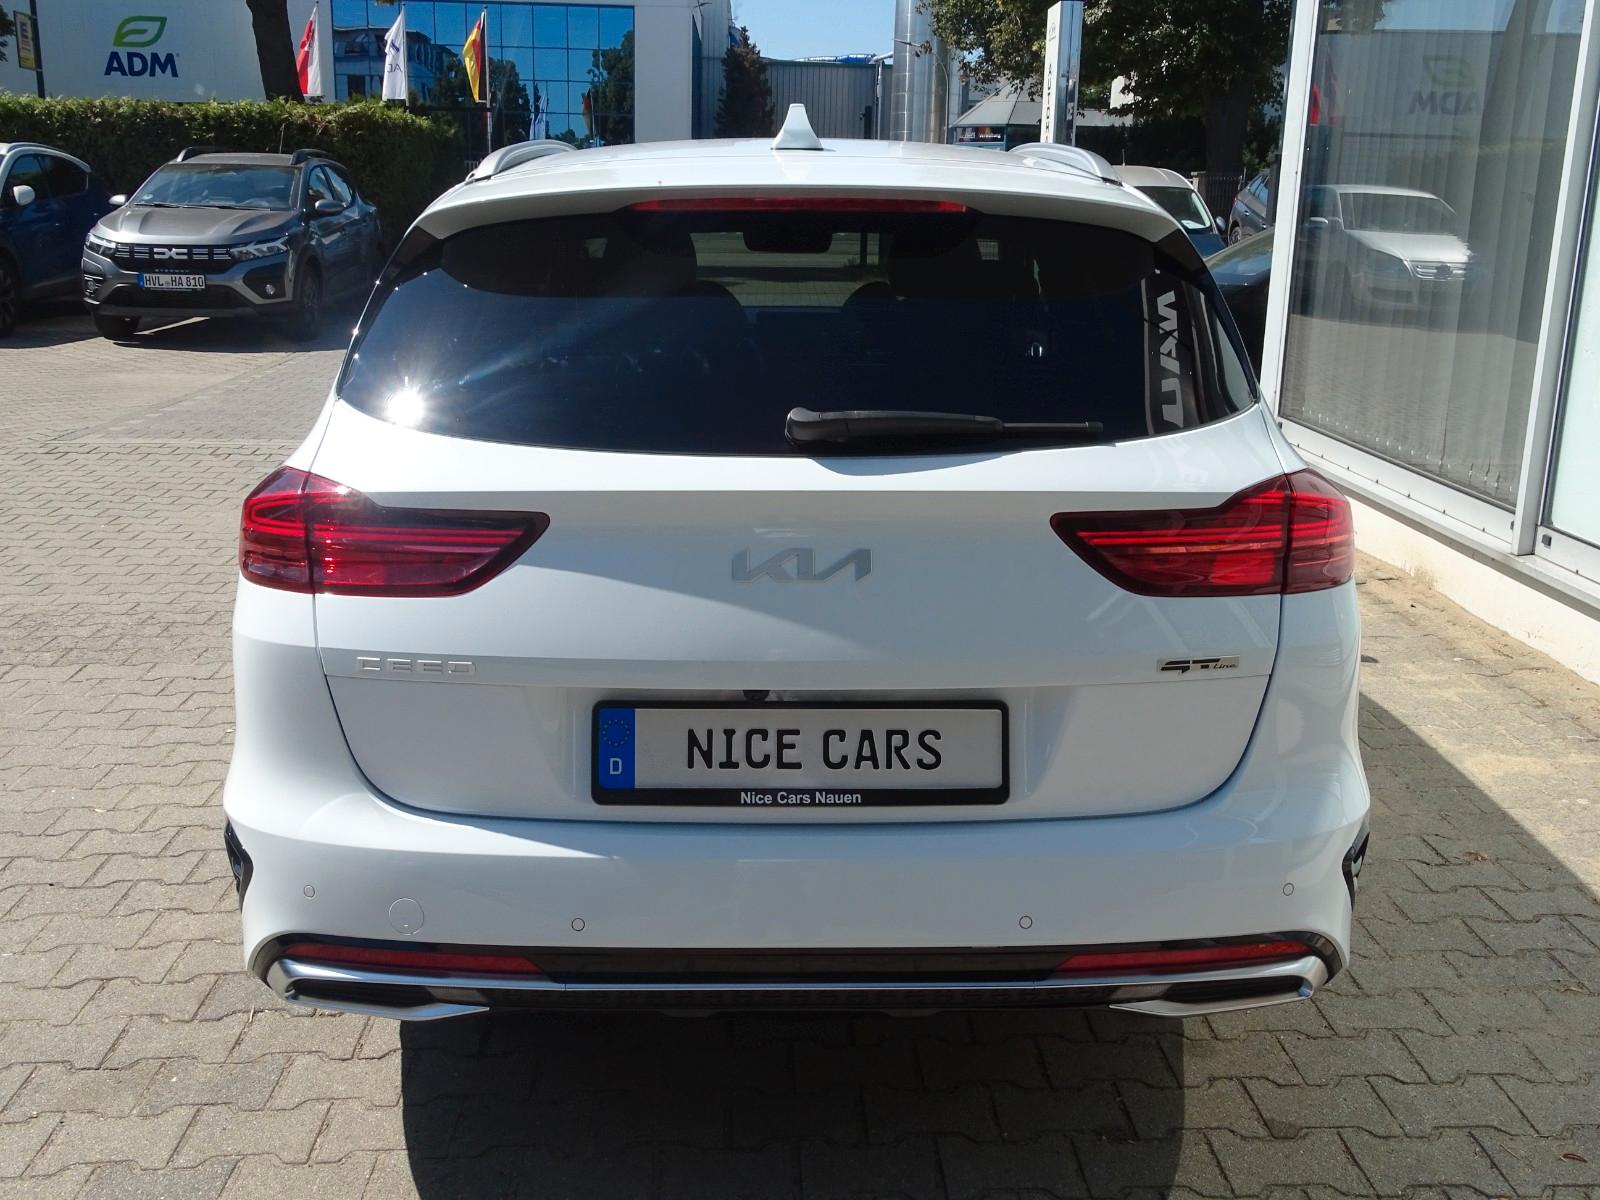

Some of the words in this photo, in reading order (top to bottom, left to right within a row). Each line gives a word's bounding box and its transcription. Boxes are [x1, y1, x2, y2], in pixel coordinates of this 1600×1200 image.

[104, 51, 178, 77] ADM
[144, 275, 164, 287] HVL
[170, 276, 184, 287] HA
[185, 276, 204, 288] 810
[356, 656, 478, 674] CEED
[686, 727, 801, 770] NICE
[822, 727, 943, 770] CARS
[609, 757, 622, 775] D
[740, 791, 773, 805] Nice
[776, 791, 811, 805] Cars
[815, 791, 862, 805] Nauen
